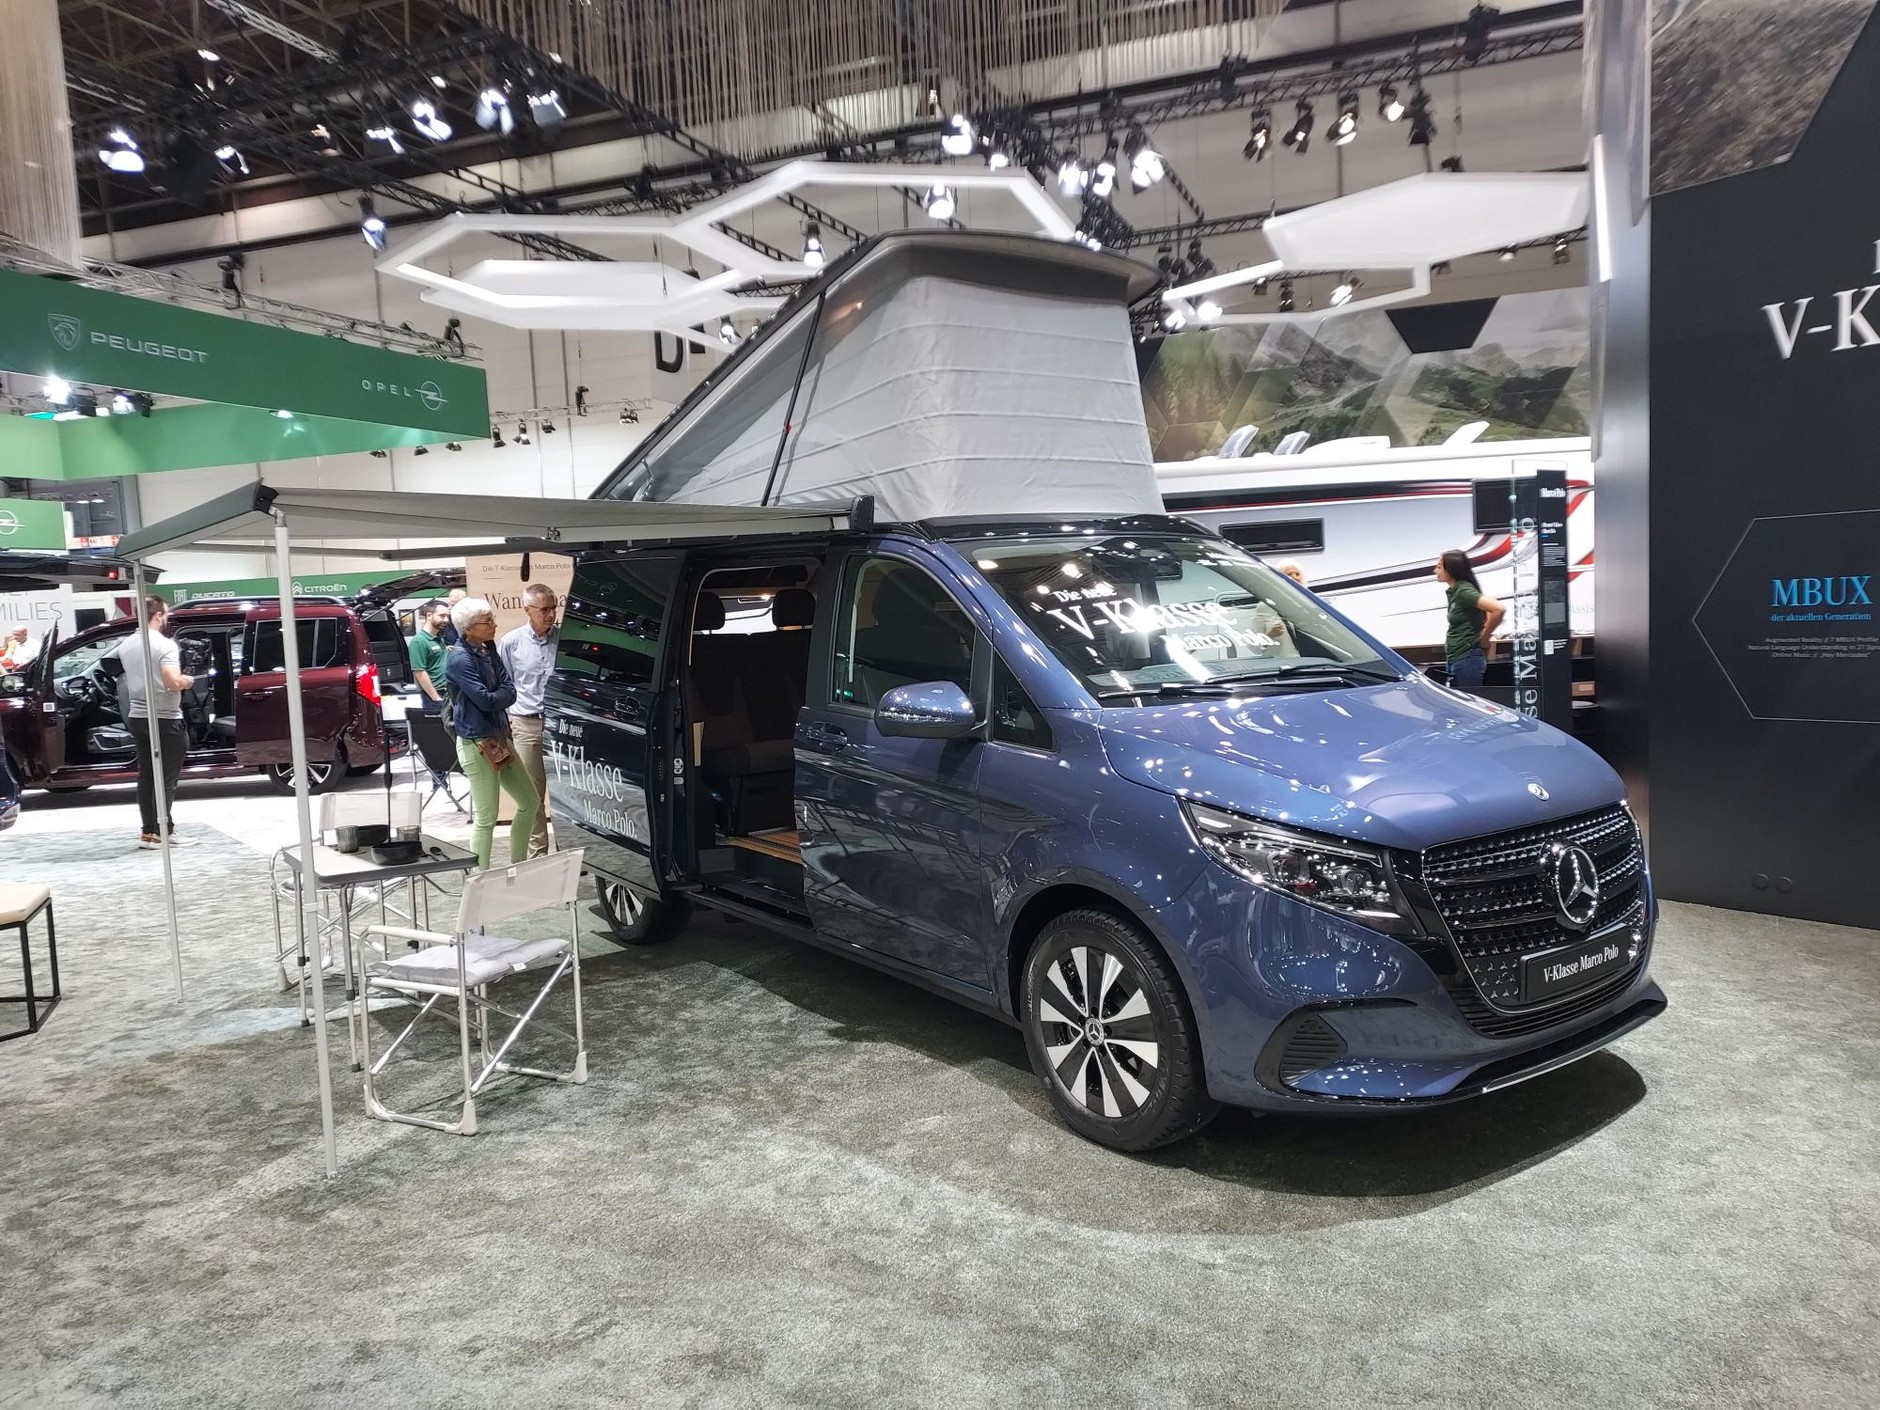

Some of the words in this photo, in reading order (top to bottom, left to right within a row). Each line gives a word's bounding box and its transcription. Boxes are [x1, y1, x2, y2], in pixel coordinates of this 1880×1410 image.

[90, 331, 209, 363] PEUGEOT
[361, 380, 413, 397] OPEL
[1770, 575, 1873, 607] MBUX
[1825, 611, 1872, 621] Generation
[550, 739, 624, 803] V-Klasse
[583, 799, 612, 831] Marco
[1543, 962, 1579, 983] V-Klasse
[1580, 953, 1603, 972] Marco
[1603, 944, 1619, 962] Polo
